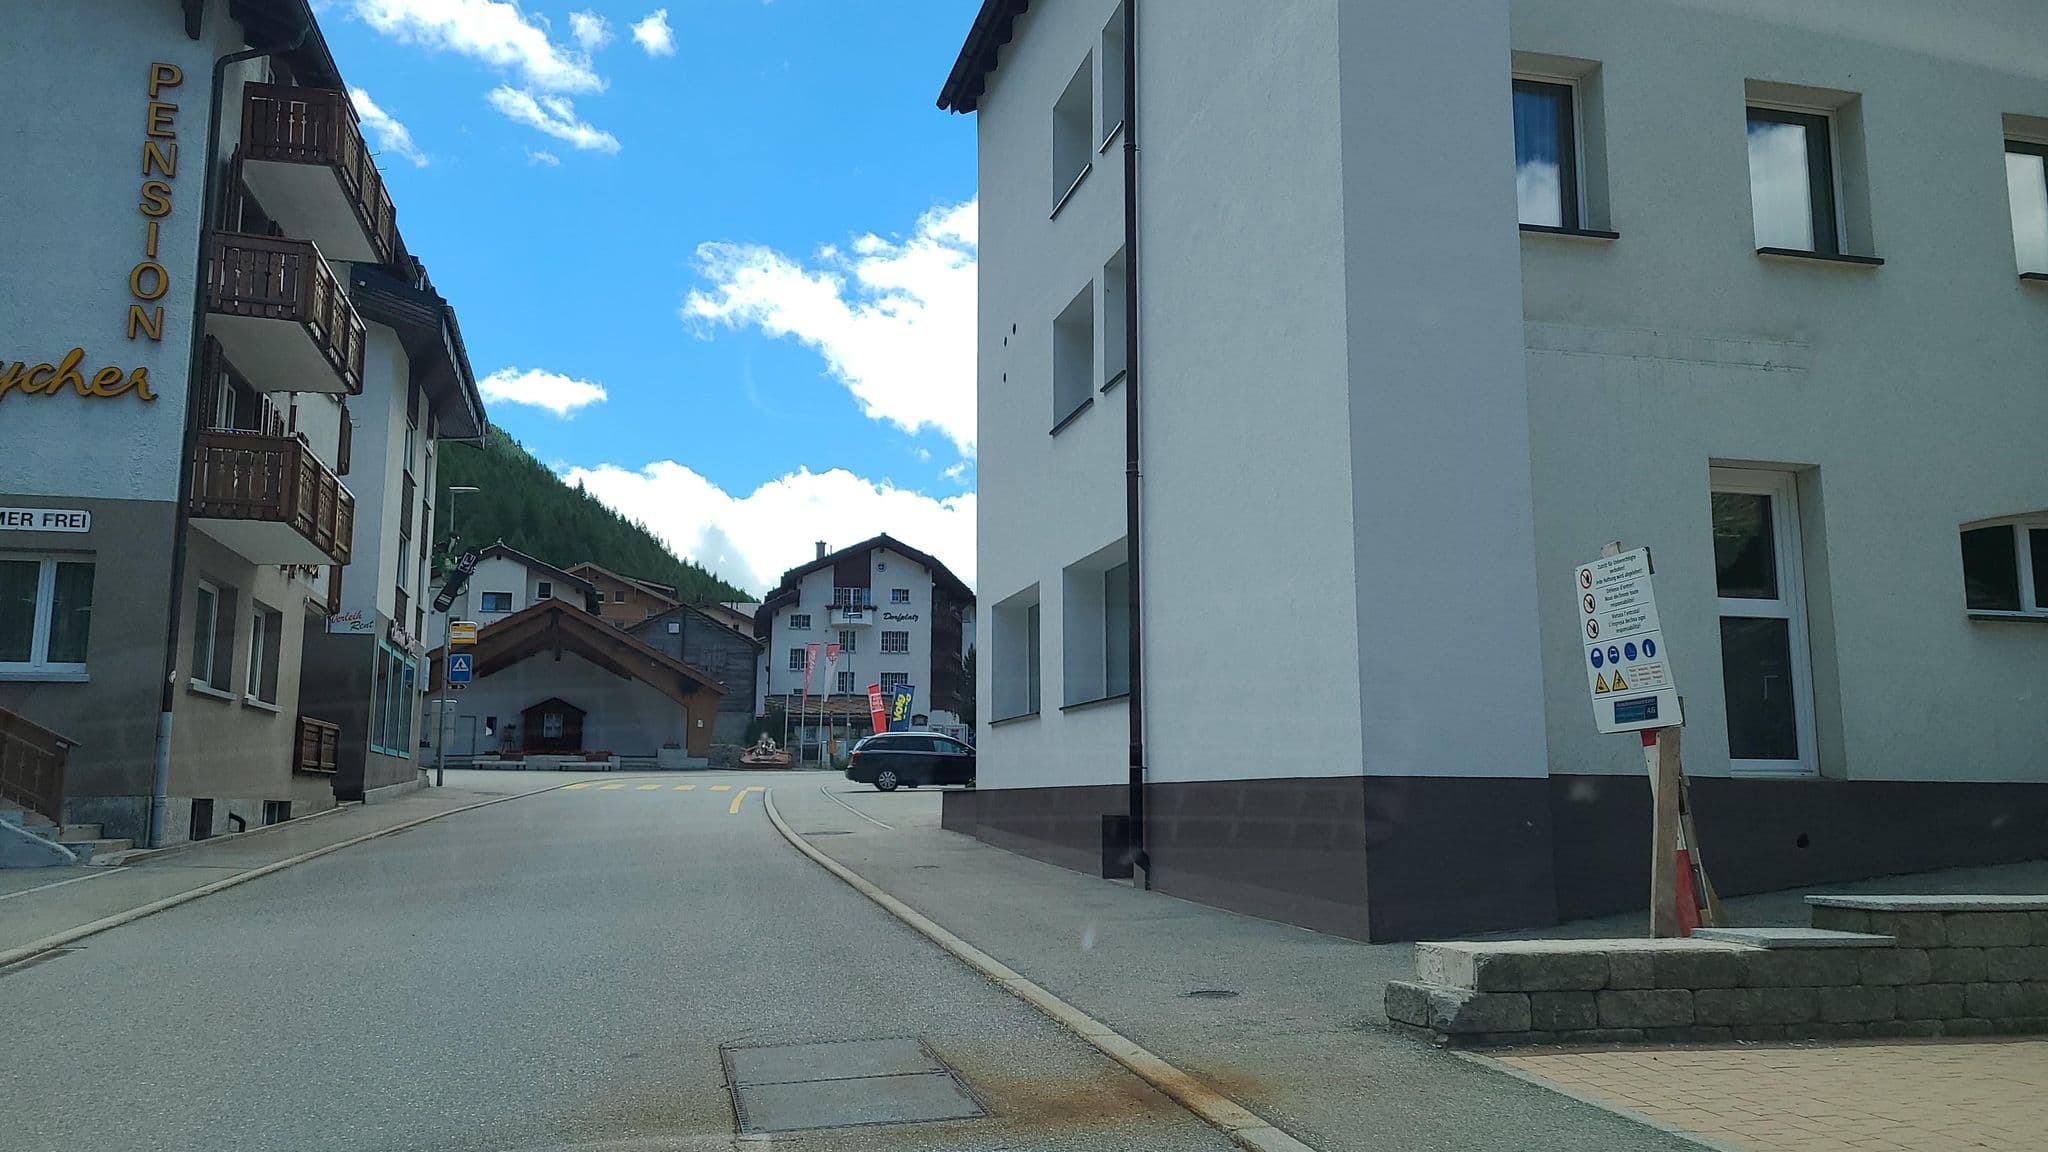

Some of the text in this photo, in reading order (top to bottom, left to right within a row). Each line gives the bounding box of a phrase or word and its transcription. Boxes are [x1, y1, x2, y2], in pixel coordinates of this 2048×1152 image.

[127, 62, 184, 342] PENSION
[42, 513, 87, 528] FREI
[883, 612, 919, 622] Dorfplatz
[350, 620, 374, 631] Rent
